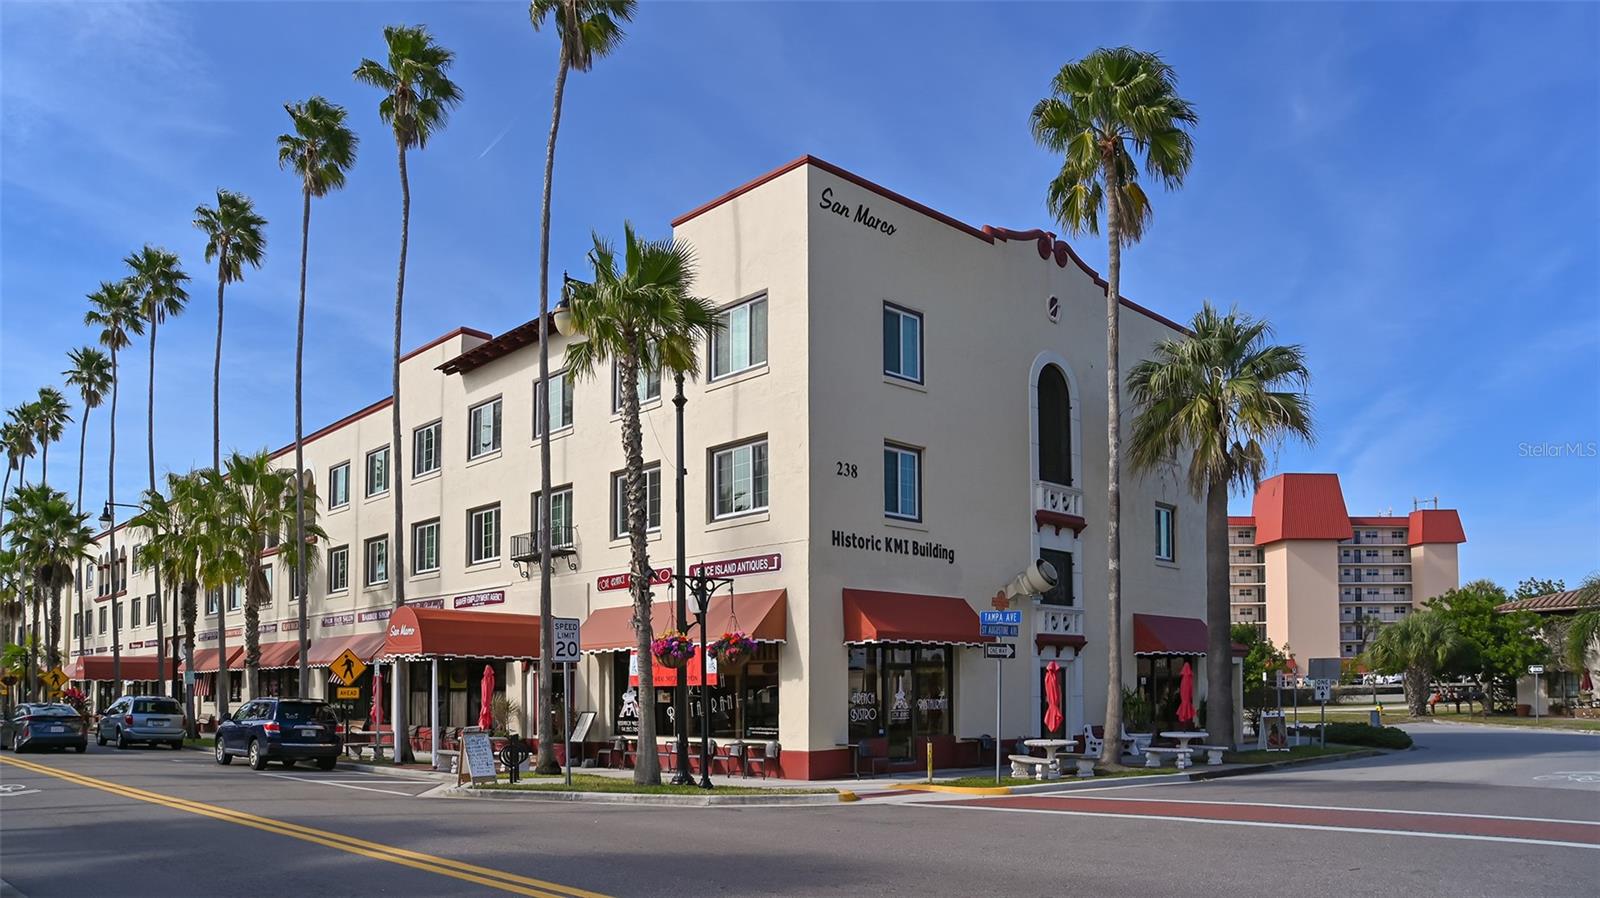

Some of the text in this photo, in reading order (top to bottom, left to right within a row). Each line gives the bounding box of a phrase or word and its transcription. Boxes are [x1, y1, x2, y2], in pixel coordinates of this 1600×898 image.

[819, 187, 897, 236] San Marco
[836, 461, 858, 479] 238
[831, 529, 955, 564] Historic KMI Building
[715, 562, 737, 575] ISLAND
[737, 558, 769, 573] ANTIQUES
[984, 612, 1017, 622] TAMPA AVE
[554, 622, 578, 631] SPEED
[557, 632, 575, 640] LIMIT
[555, 641, 578, 657] 20
